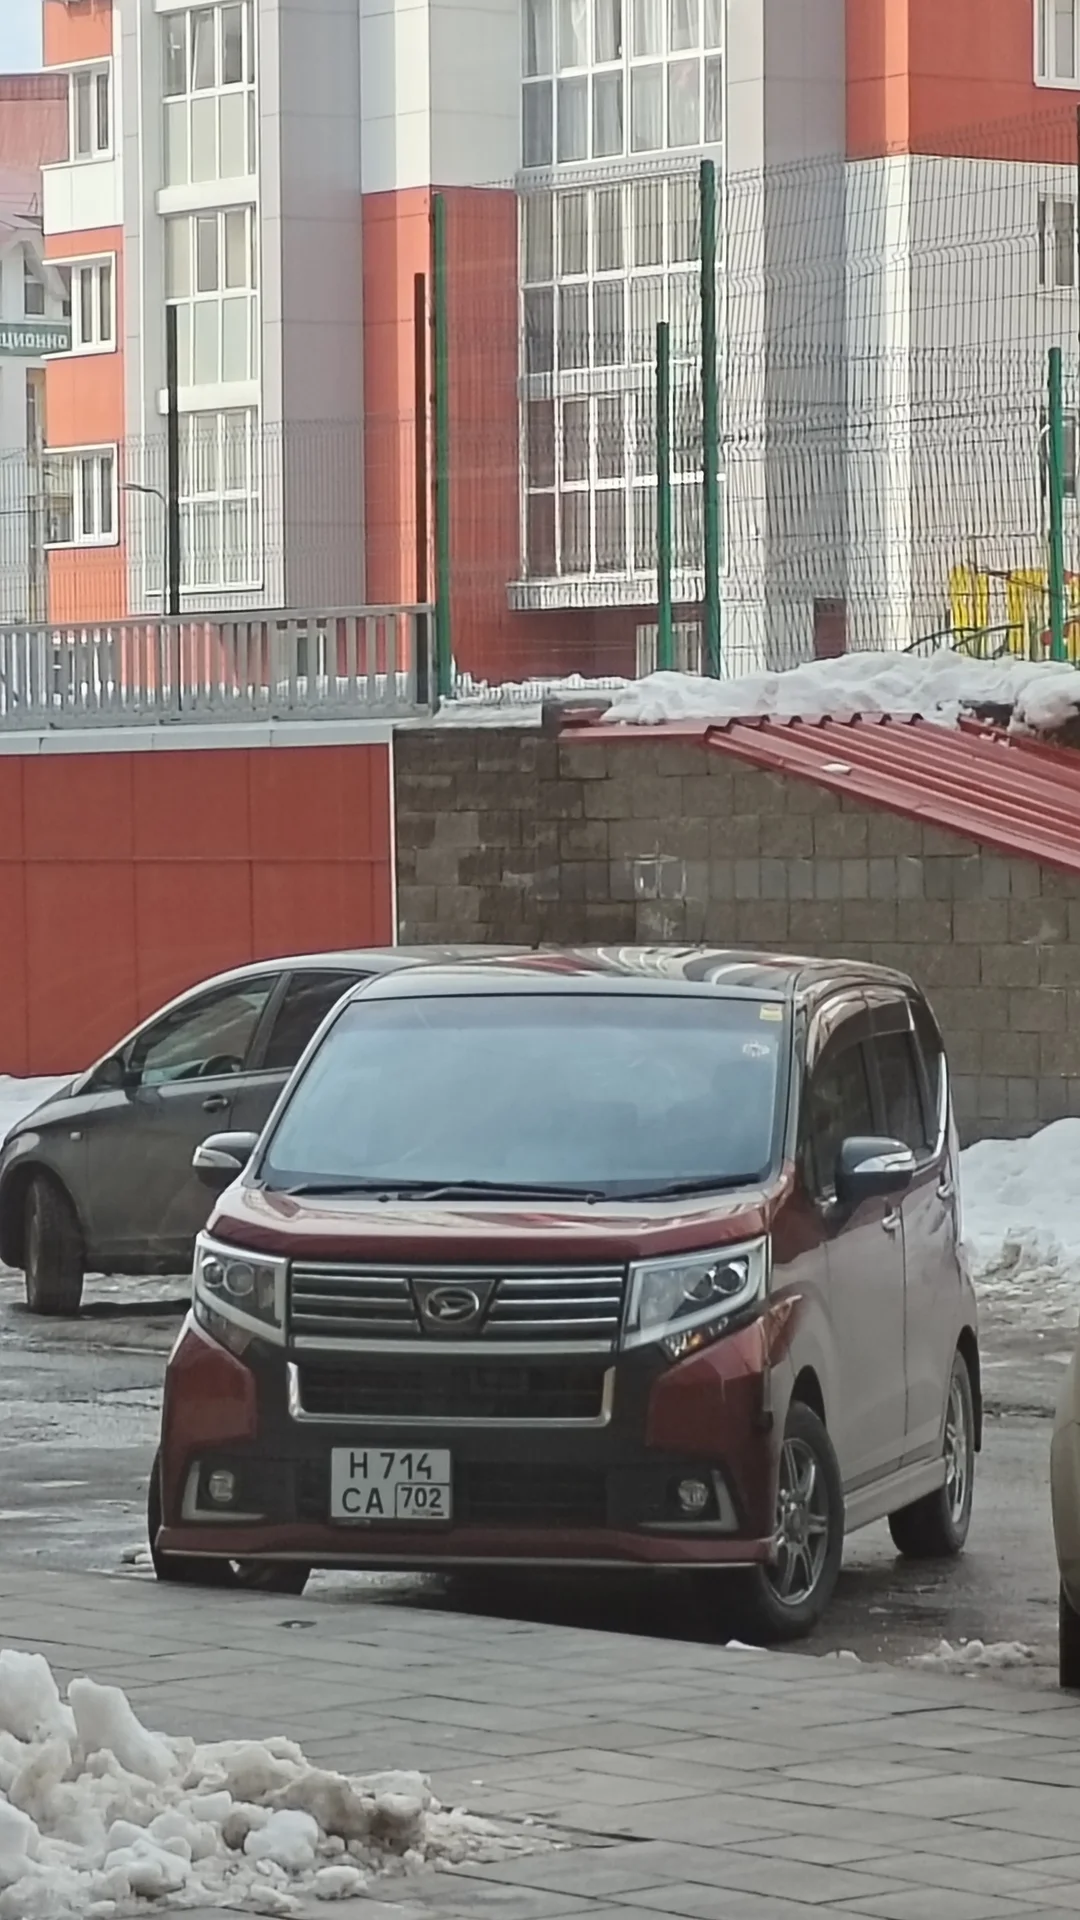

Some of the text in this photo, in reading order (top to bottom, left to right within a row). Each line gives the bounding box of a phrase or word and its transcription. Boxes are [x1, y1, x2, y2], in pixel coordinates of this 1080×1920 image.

[0, 332, 68, 349] ЦИОННО
[380, 1452, 431, 1480] 714
[400, 1487, 441, 1508] 702
